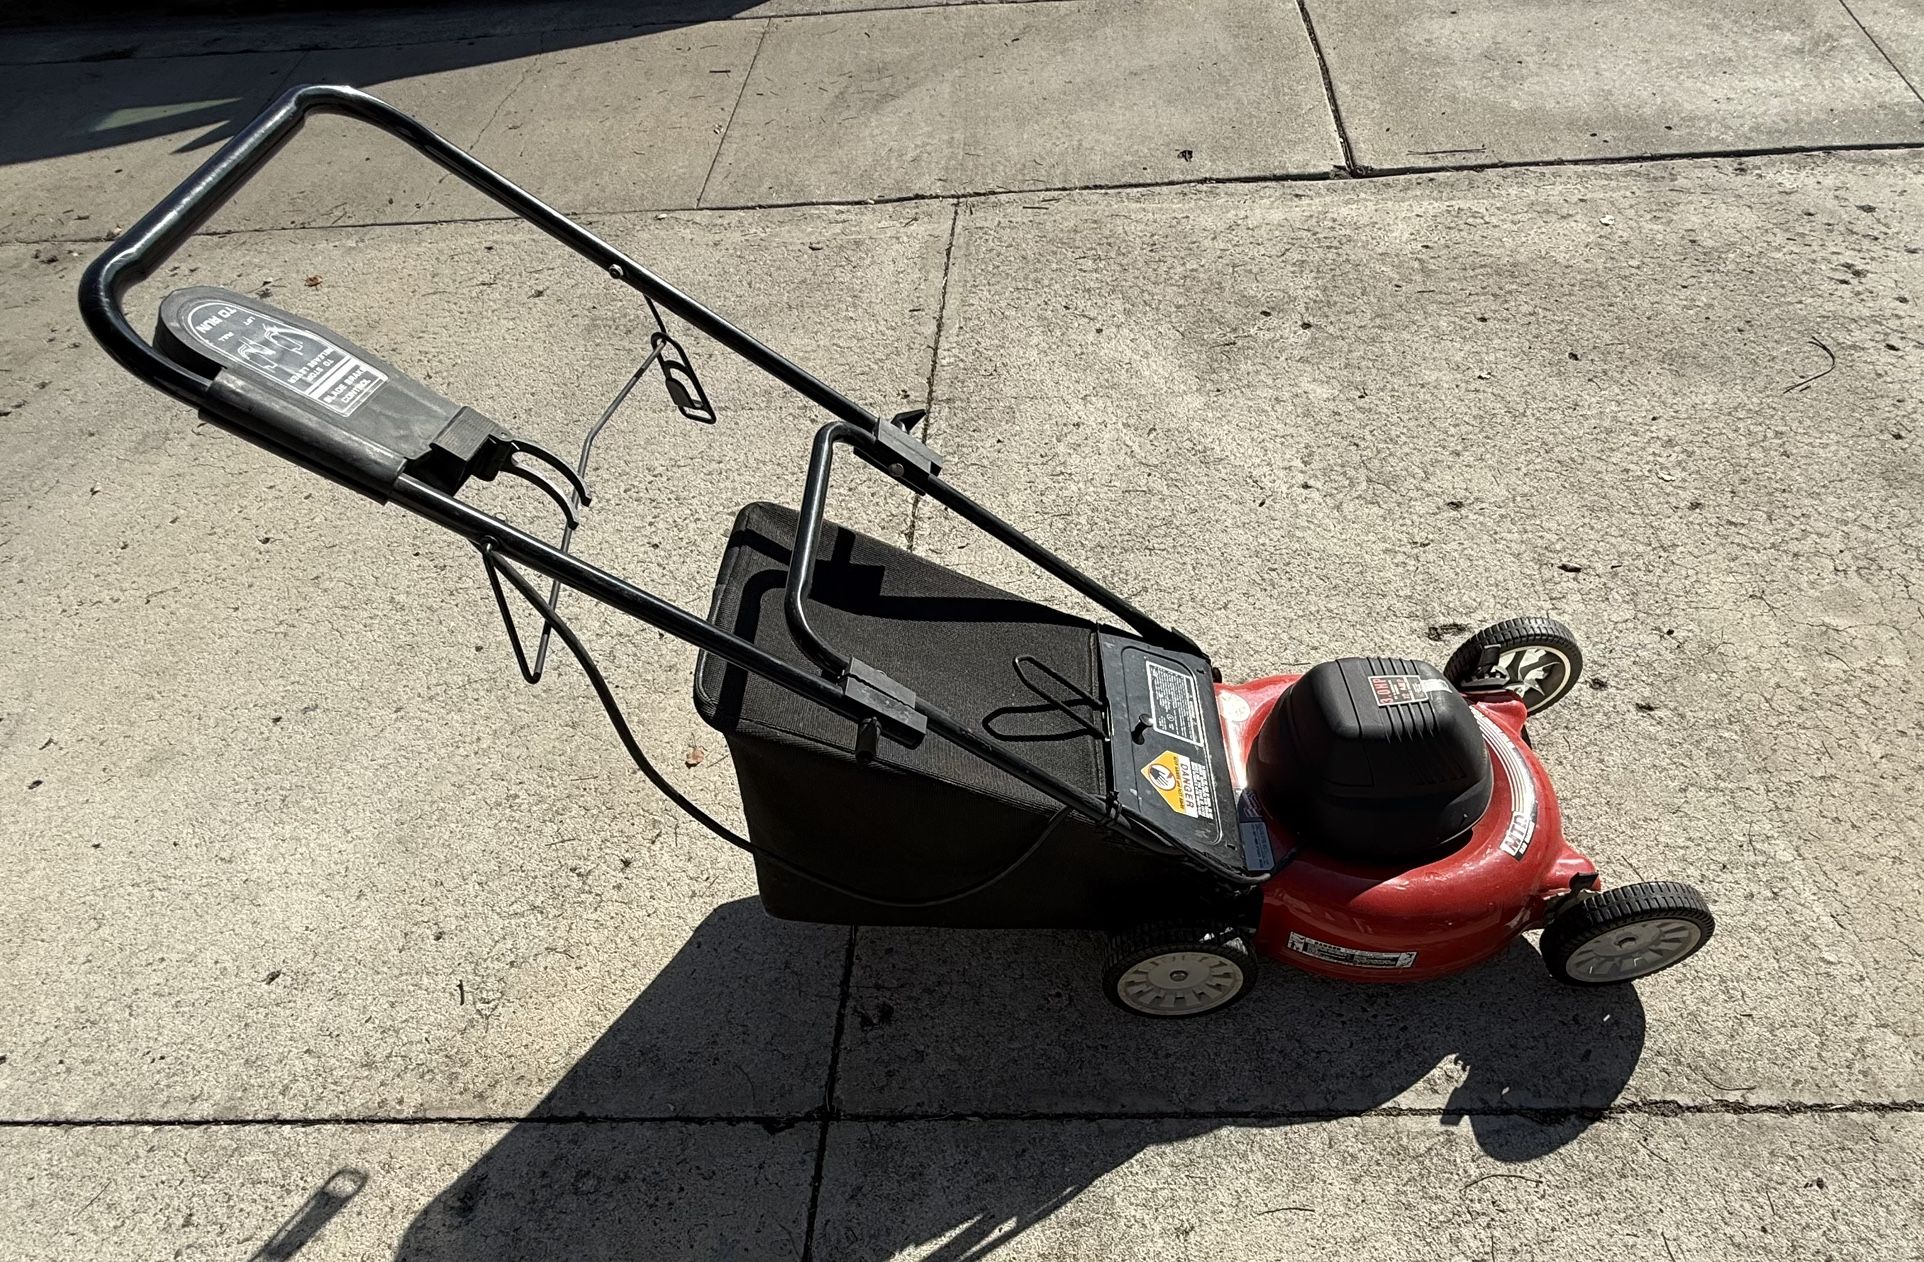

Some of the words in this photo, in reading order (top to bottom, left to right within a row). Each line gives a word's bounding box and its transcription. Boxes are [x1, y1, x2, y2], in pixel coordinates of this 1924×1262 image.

[218, 307, 237, 318] TO
[195, 316, 223, 334] RUN
[324, 384, 348, 404] BLADE
[341, 378, 372, 403] CONTROL
[1180, 764, 1194, 808] DANGER
[1504, 814, 1527, 852] MTD
